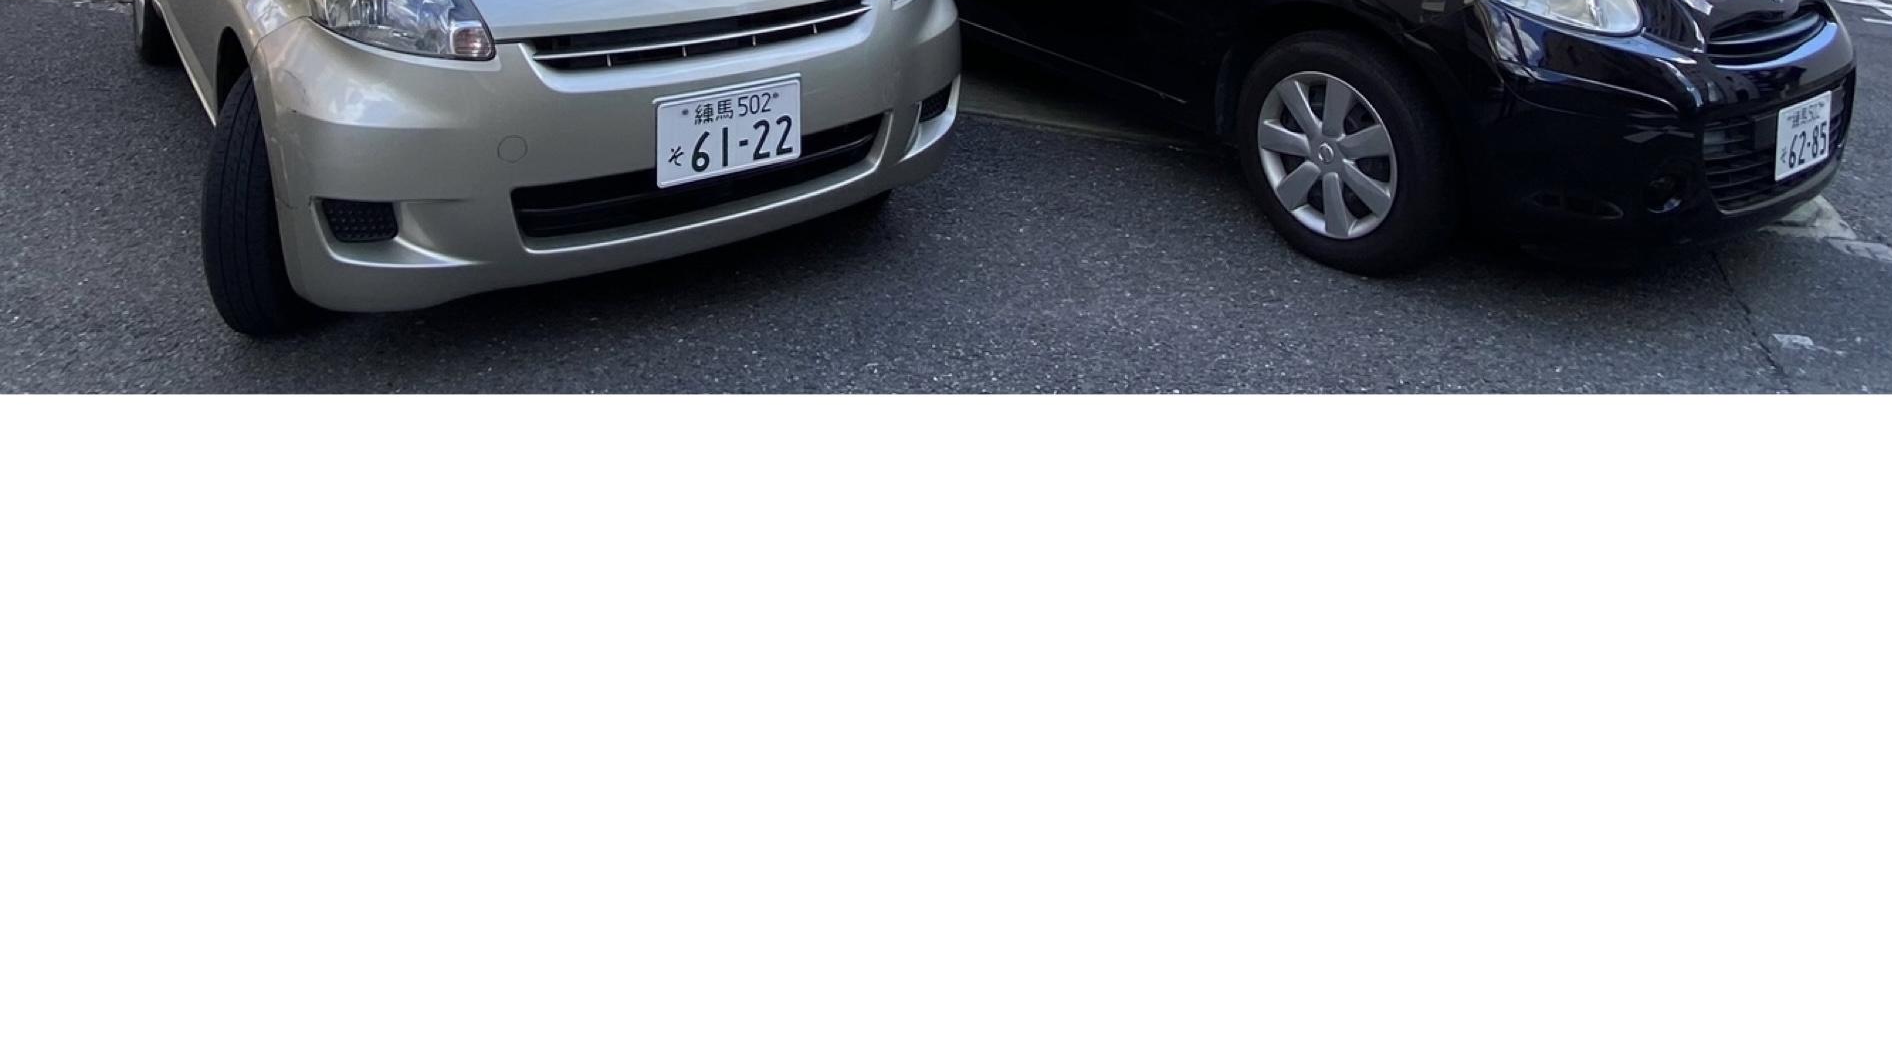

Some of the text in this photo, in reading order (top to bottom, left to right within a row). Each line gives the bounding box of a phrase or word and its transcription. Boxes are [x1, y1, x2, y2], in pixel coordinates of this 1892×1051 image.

[694, 92, 771, 125] 練馬 502
[668, 115, 793, 172] そ 61-22
[1789, 121, 1828, 169] 62-85
